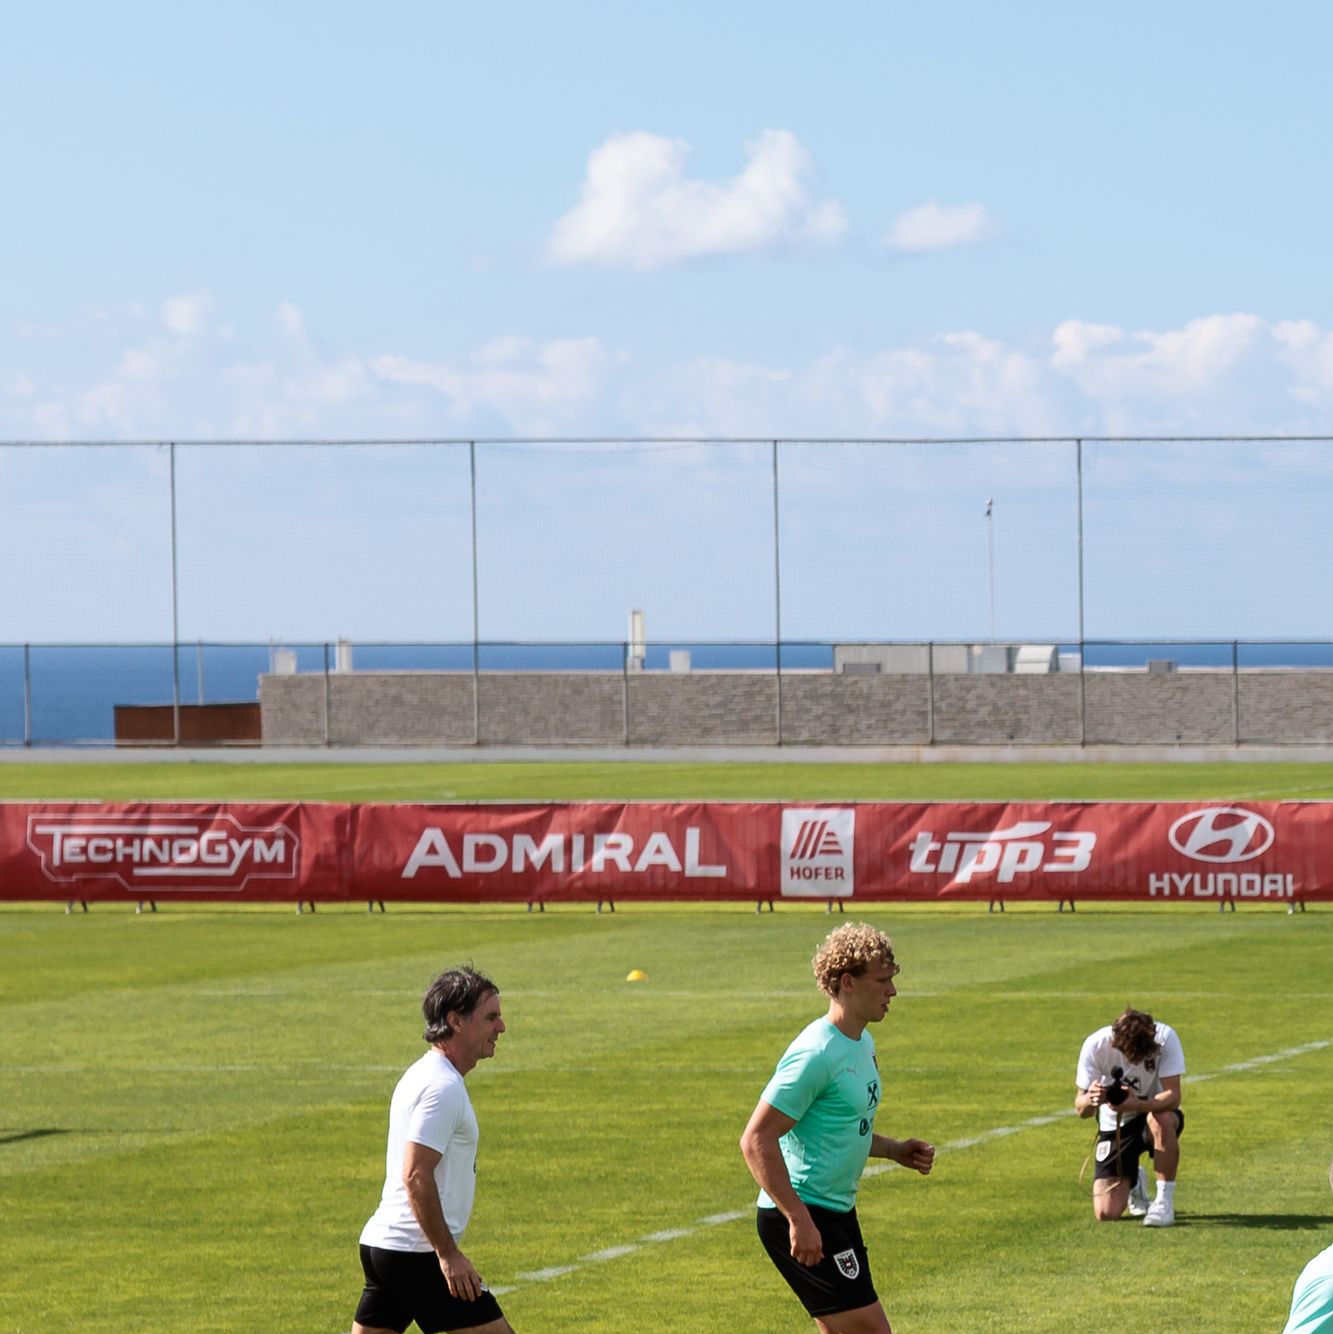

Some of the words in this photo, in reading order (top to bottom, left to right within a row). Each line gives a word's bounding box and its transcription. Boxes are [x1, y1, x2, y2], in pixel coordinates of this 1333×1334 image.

[401, 827, 727, 878] ADMIRAL
[908, 821, 1097, 883] tipp3
[790, 867, 845, 880] HOFER
[1149, 872, 1293, 896] HYUNDAI
